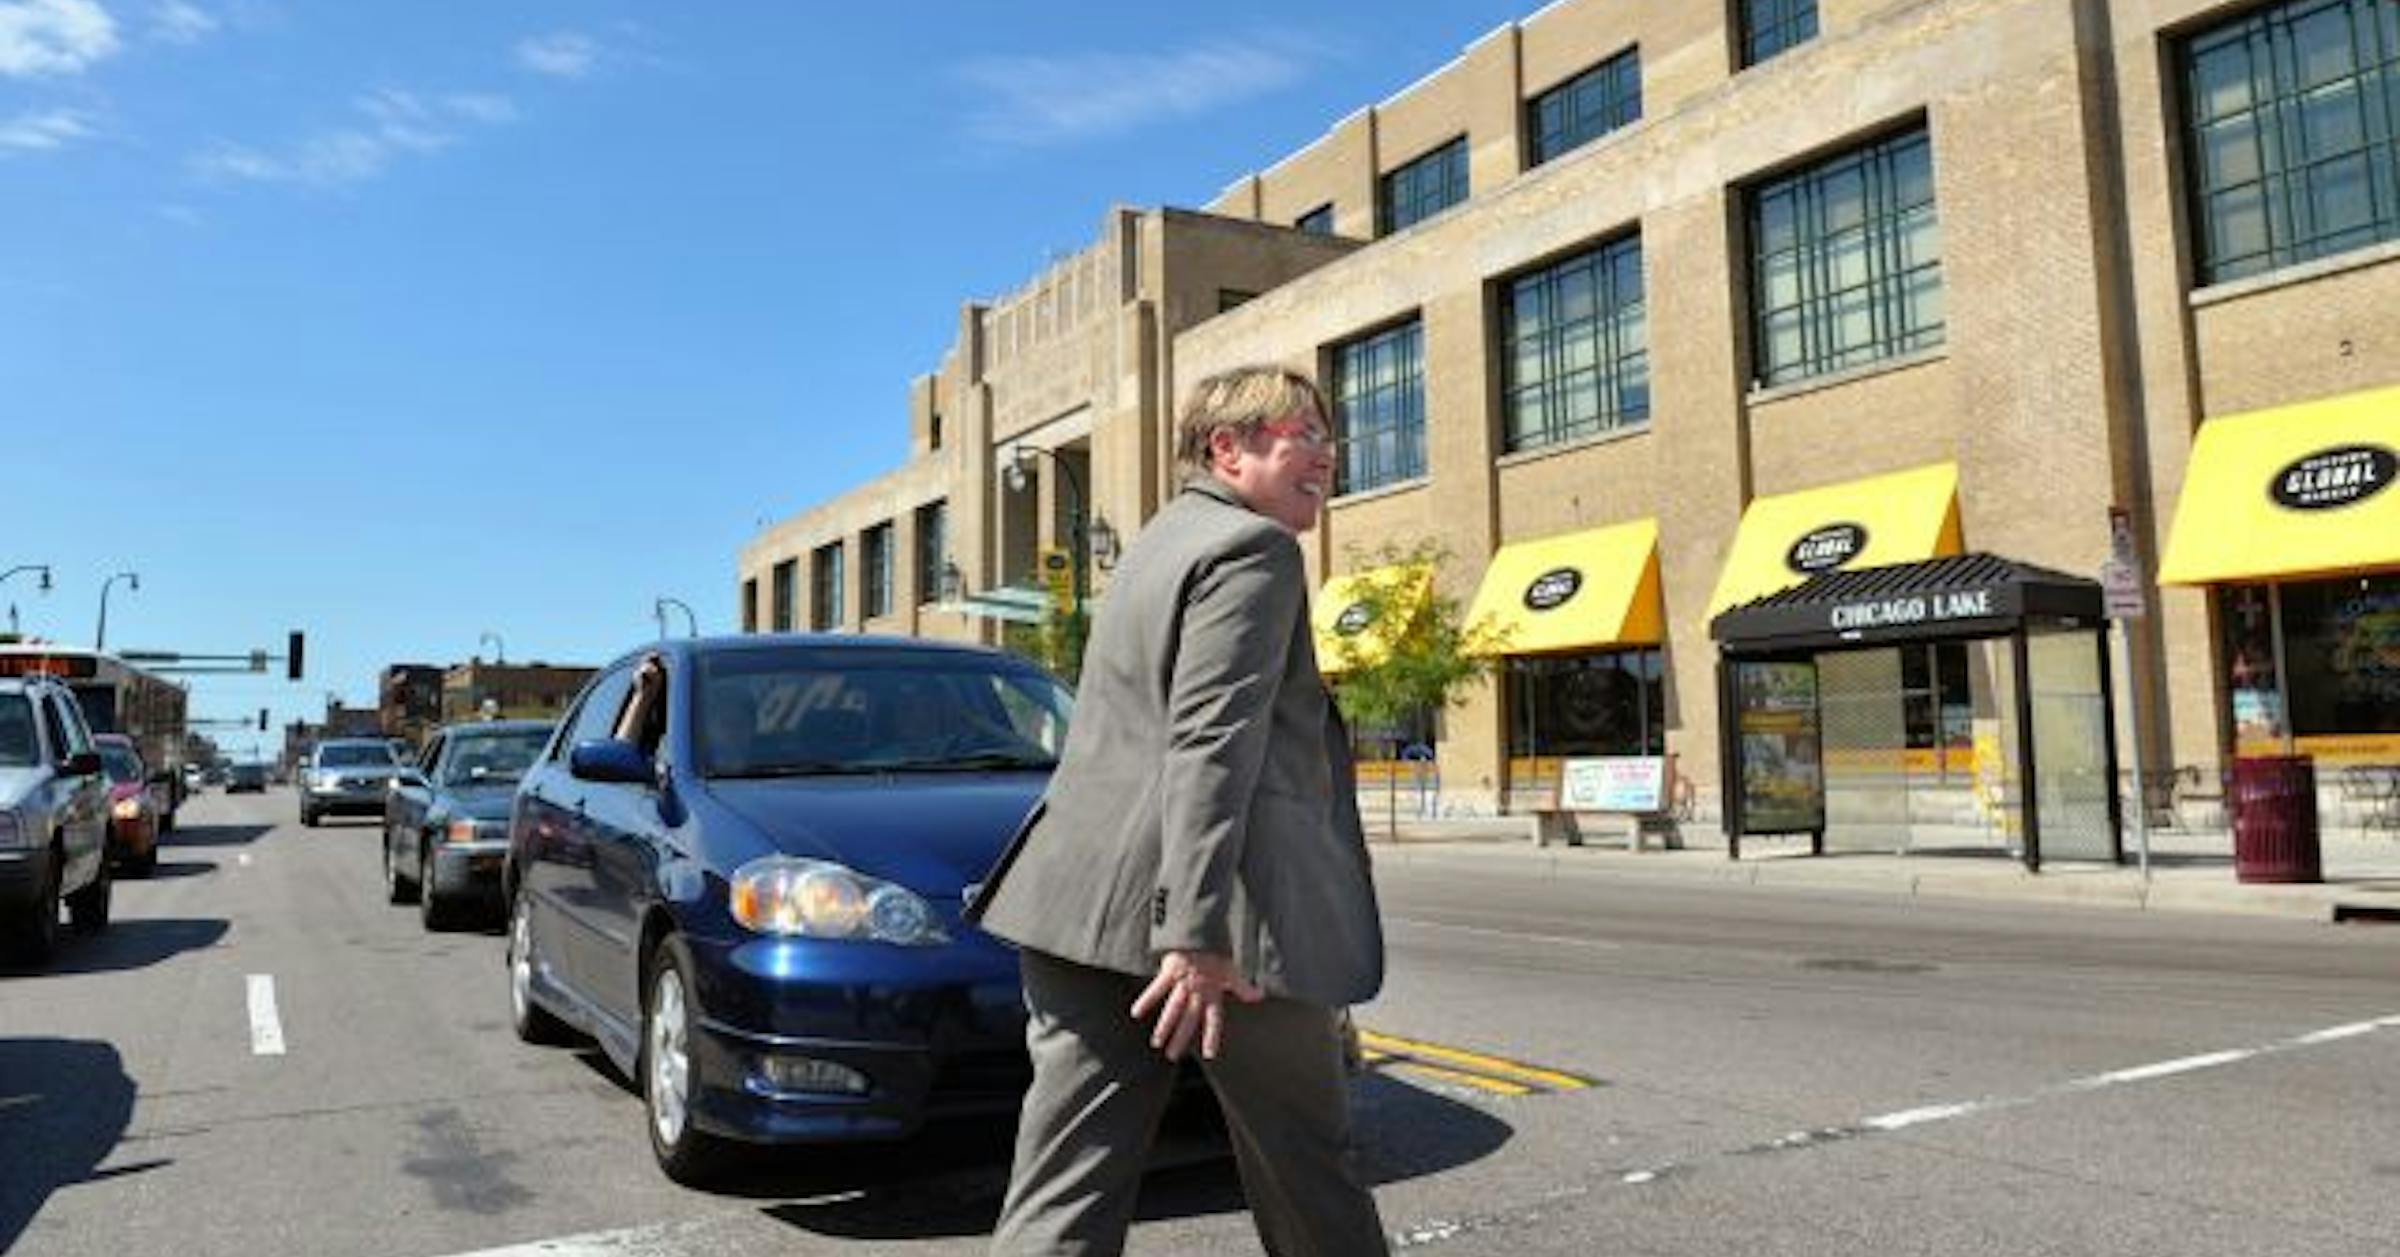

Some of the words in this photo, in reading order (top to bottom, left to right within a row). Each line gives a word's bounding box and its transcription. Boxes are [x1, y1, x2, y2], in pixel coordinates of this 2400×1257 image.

[2285, 462, 2375, 493] GLOBAL
[1831, 599, 1925, 628] CHICAGO
[1933, 591, 1991, 617] LAKE
